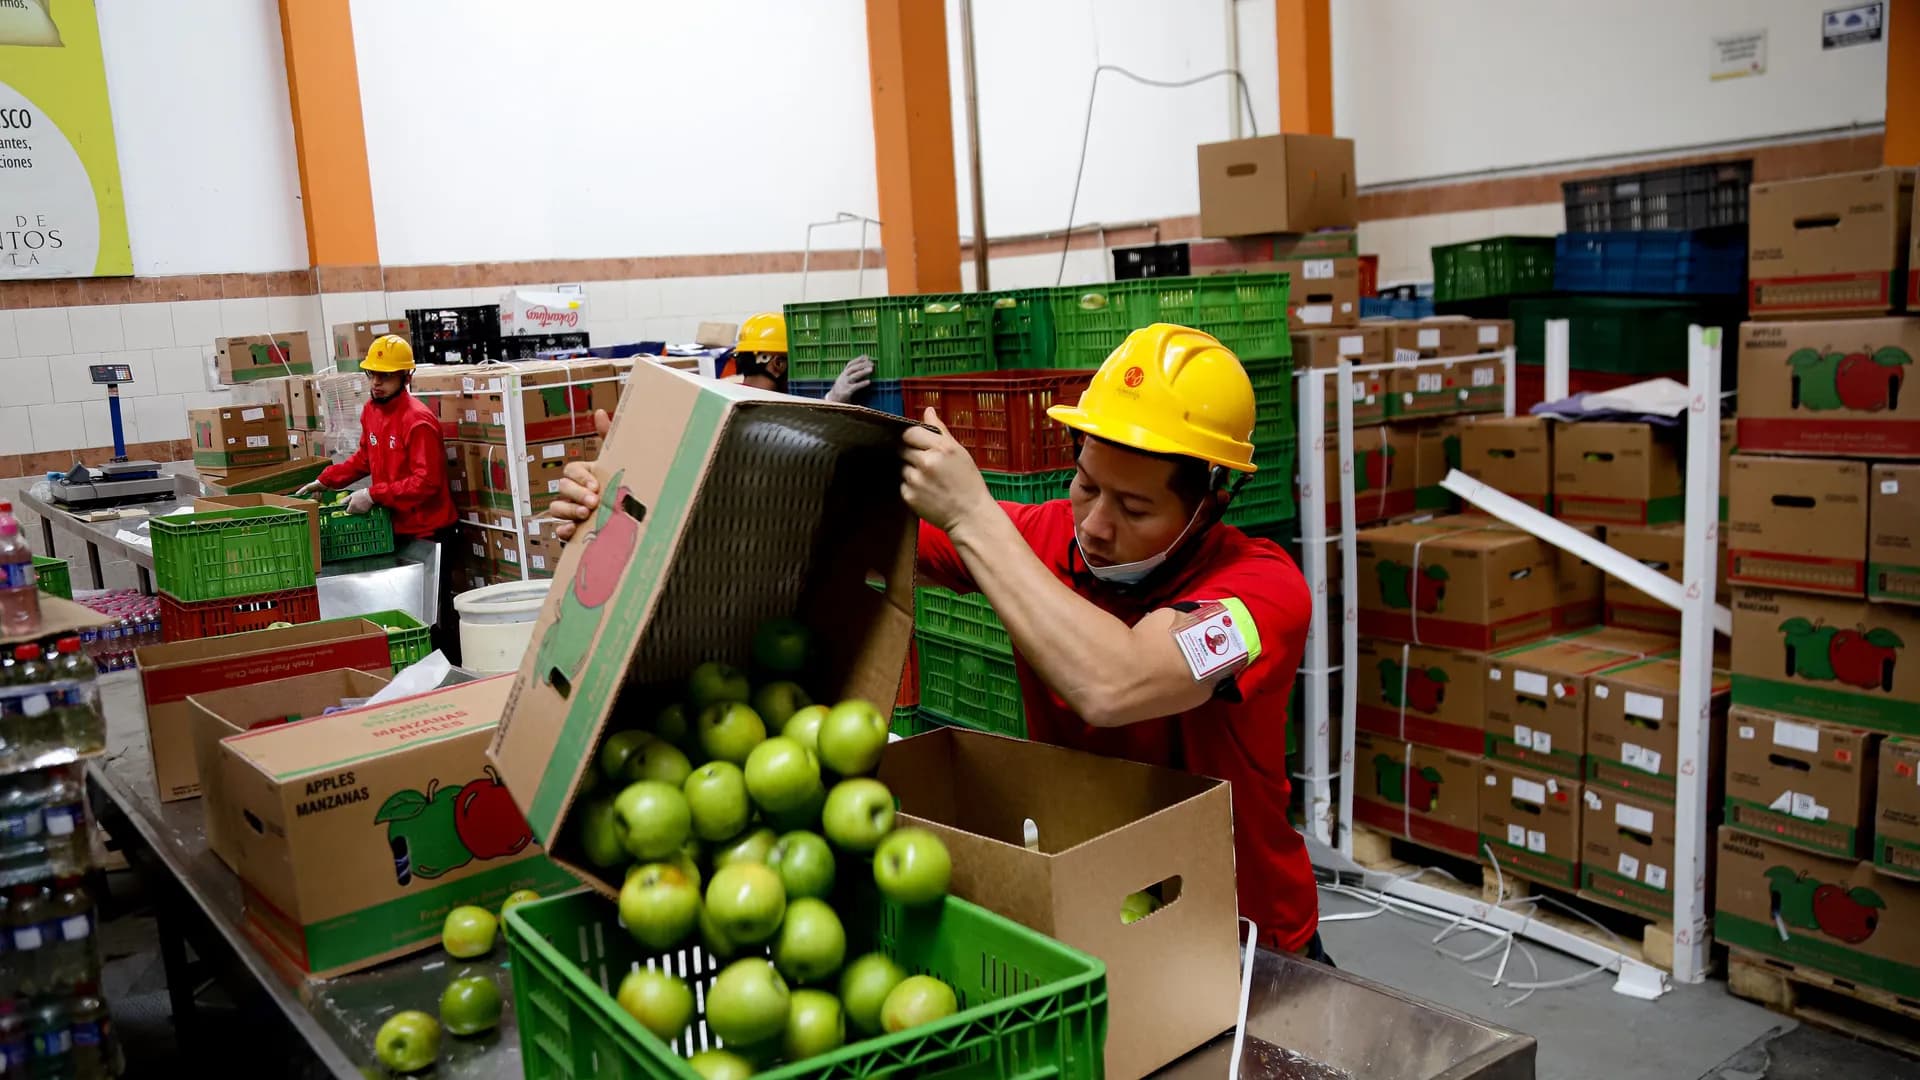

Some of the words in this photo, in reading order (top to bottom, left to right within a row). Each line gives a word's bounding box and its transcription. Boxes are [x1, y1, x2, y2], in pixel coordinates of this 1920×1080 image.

[0, 109, 32, 129] SCO
[15, 214, 47, 228] DE
[0, 229, 63, 250] TOS
[305, 771, 356, 796] APPLES
[296, 786, 370, 817] MANZANAS
